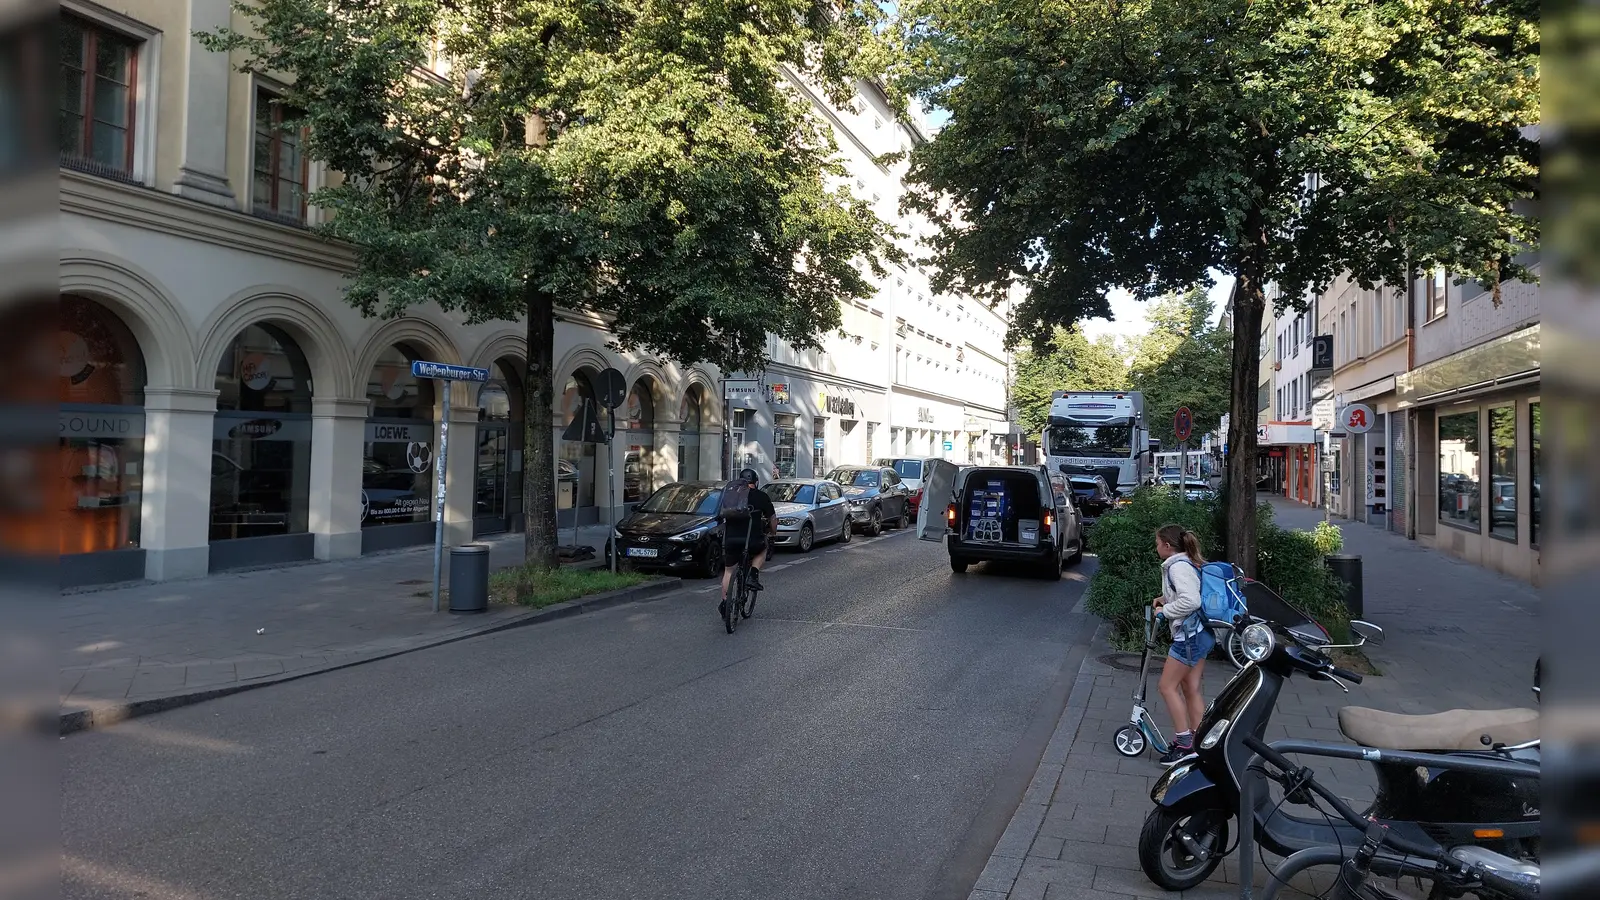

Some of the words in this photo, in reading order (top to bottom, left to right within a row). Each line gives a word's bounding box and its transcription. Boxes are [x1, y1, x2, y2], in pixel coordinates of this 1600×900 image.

[418, 362, 471, 380] Weißenburger
[472, 369, 486, 381] Str.
[236, 423, 278, 434] SAMSUNG
[1054, 457, 1088, 466] Spedition
